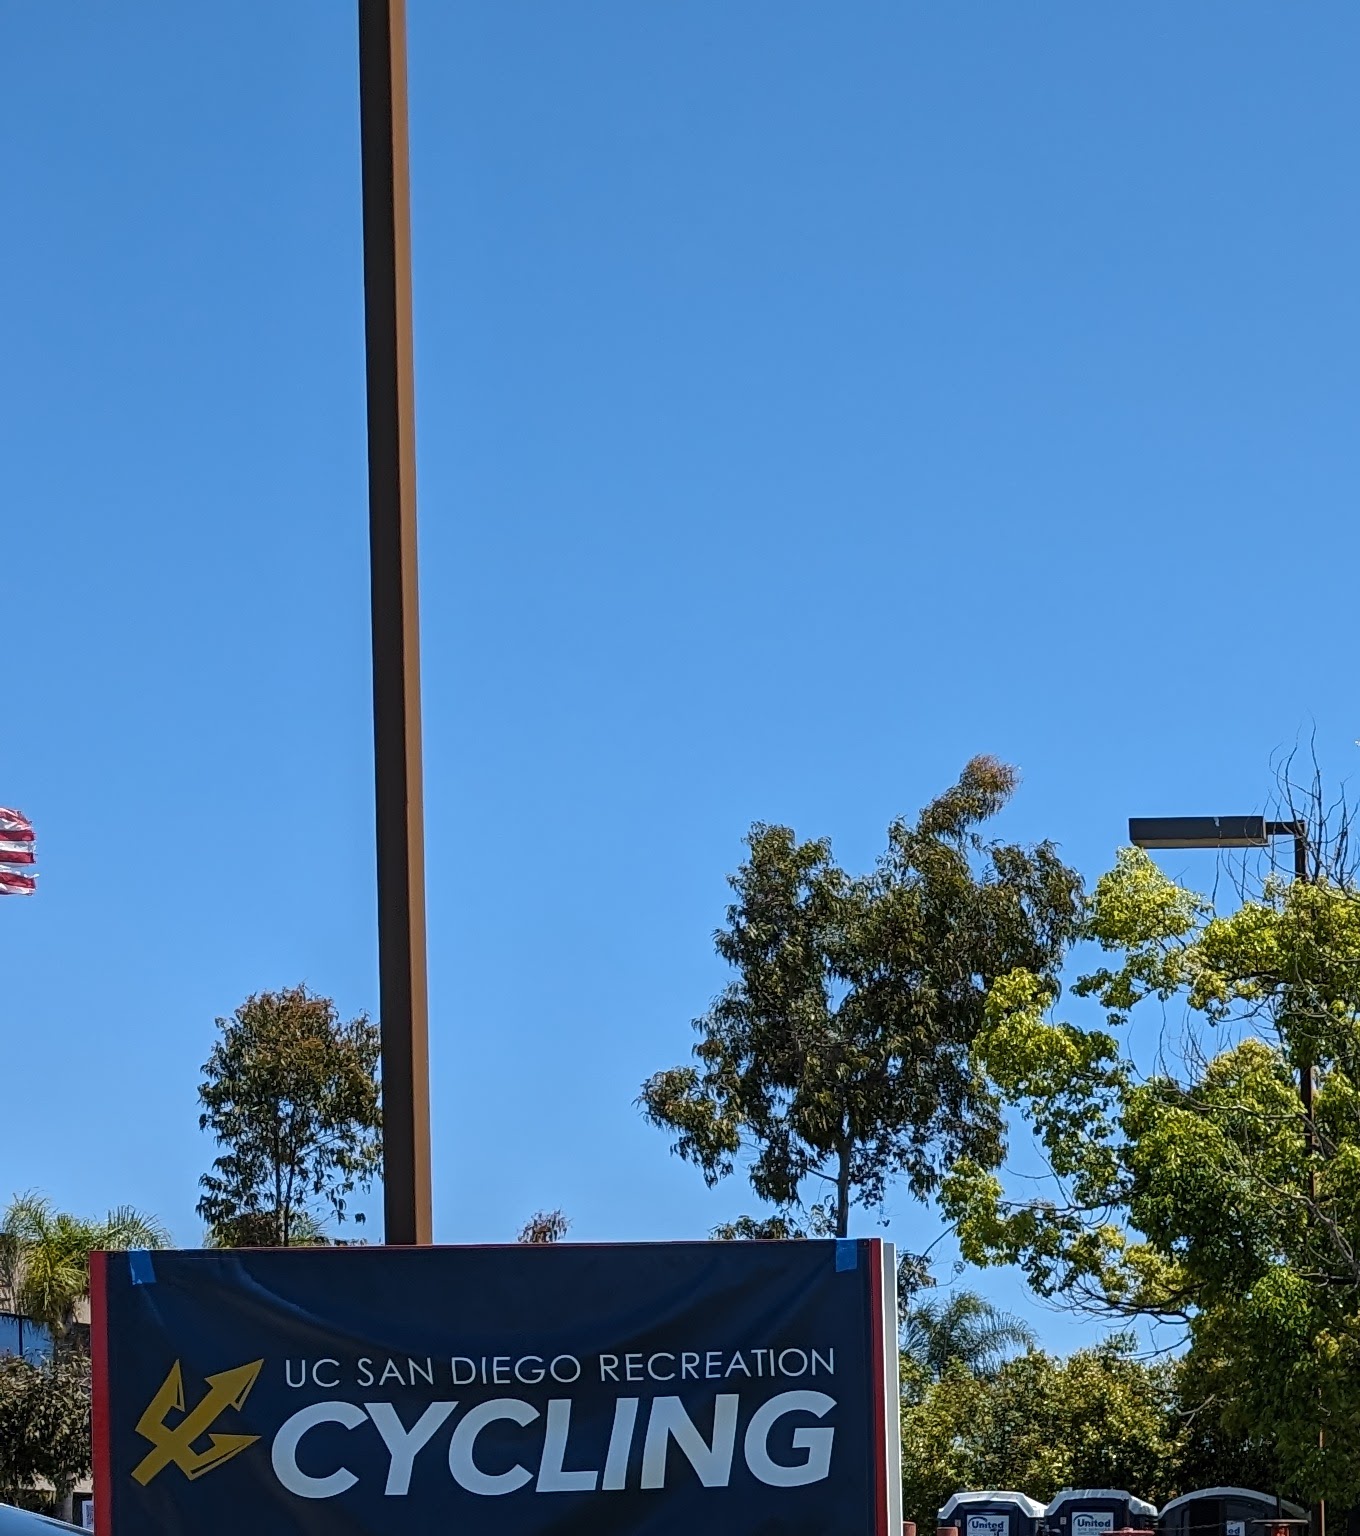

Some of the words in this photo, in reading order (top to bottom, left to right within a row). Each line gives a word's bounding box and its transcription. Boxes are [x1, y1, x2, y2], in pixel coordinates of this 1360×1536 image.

[285, 1358, 340, 1388] UC
[357, 1356, 434, 1387] SAN
[452, 1354, 582, 1385] DIEGO
[601, 1348, 835, 1382] RECREATION
[272, 1389, 838, 1499] CYCLING
[972, 1521, 1004, 1529] United
[1078, 1519, 1111, 1527] United
